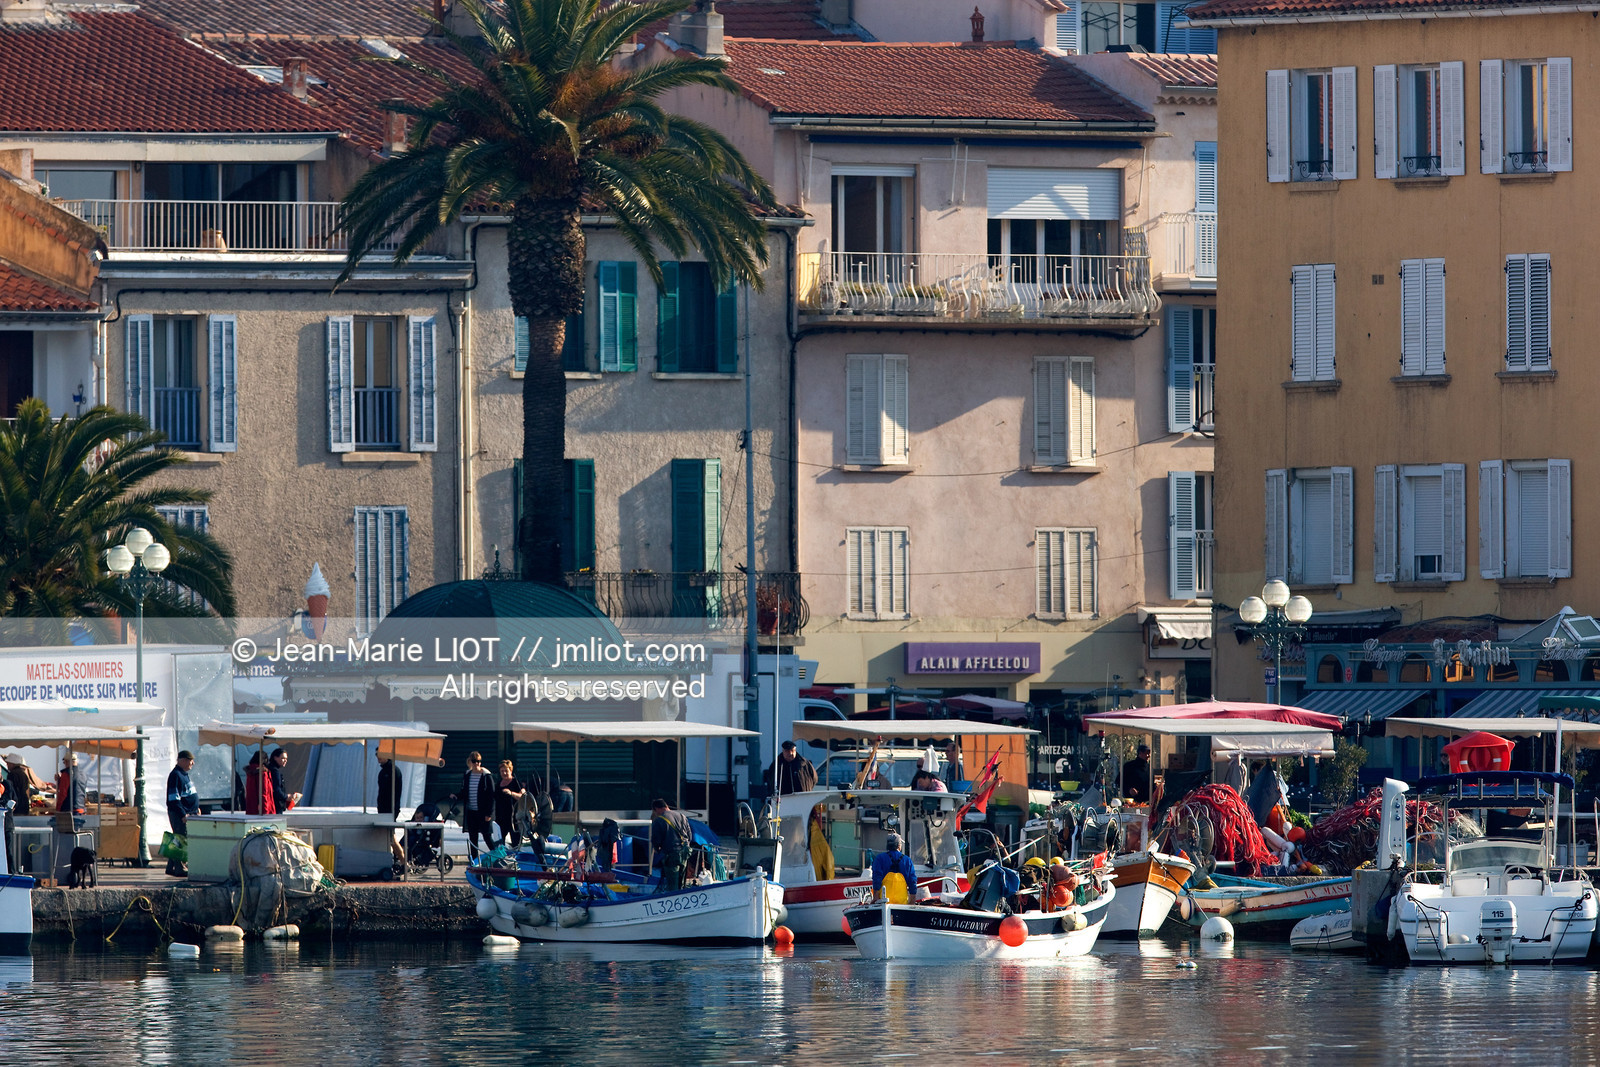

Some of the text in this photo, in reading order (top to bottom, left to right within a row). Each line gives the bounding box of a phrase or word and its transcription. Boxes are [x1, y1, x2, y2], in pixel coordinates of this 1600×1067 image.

[920, 656, 1030, 669] ALAIN AFFLELOU
[26, 661, 124, 681] MATELAS-SOMMIERS
[40, 685, 53, 700] DE
[97, 683, 117, 699] SUR
[642, 893, 709, 916] TL326292
[1492, 910, 1505, 918] 115
[930, 916, 990, 932] SAUVAGEONNE
